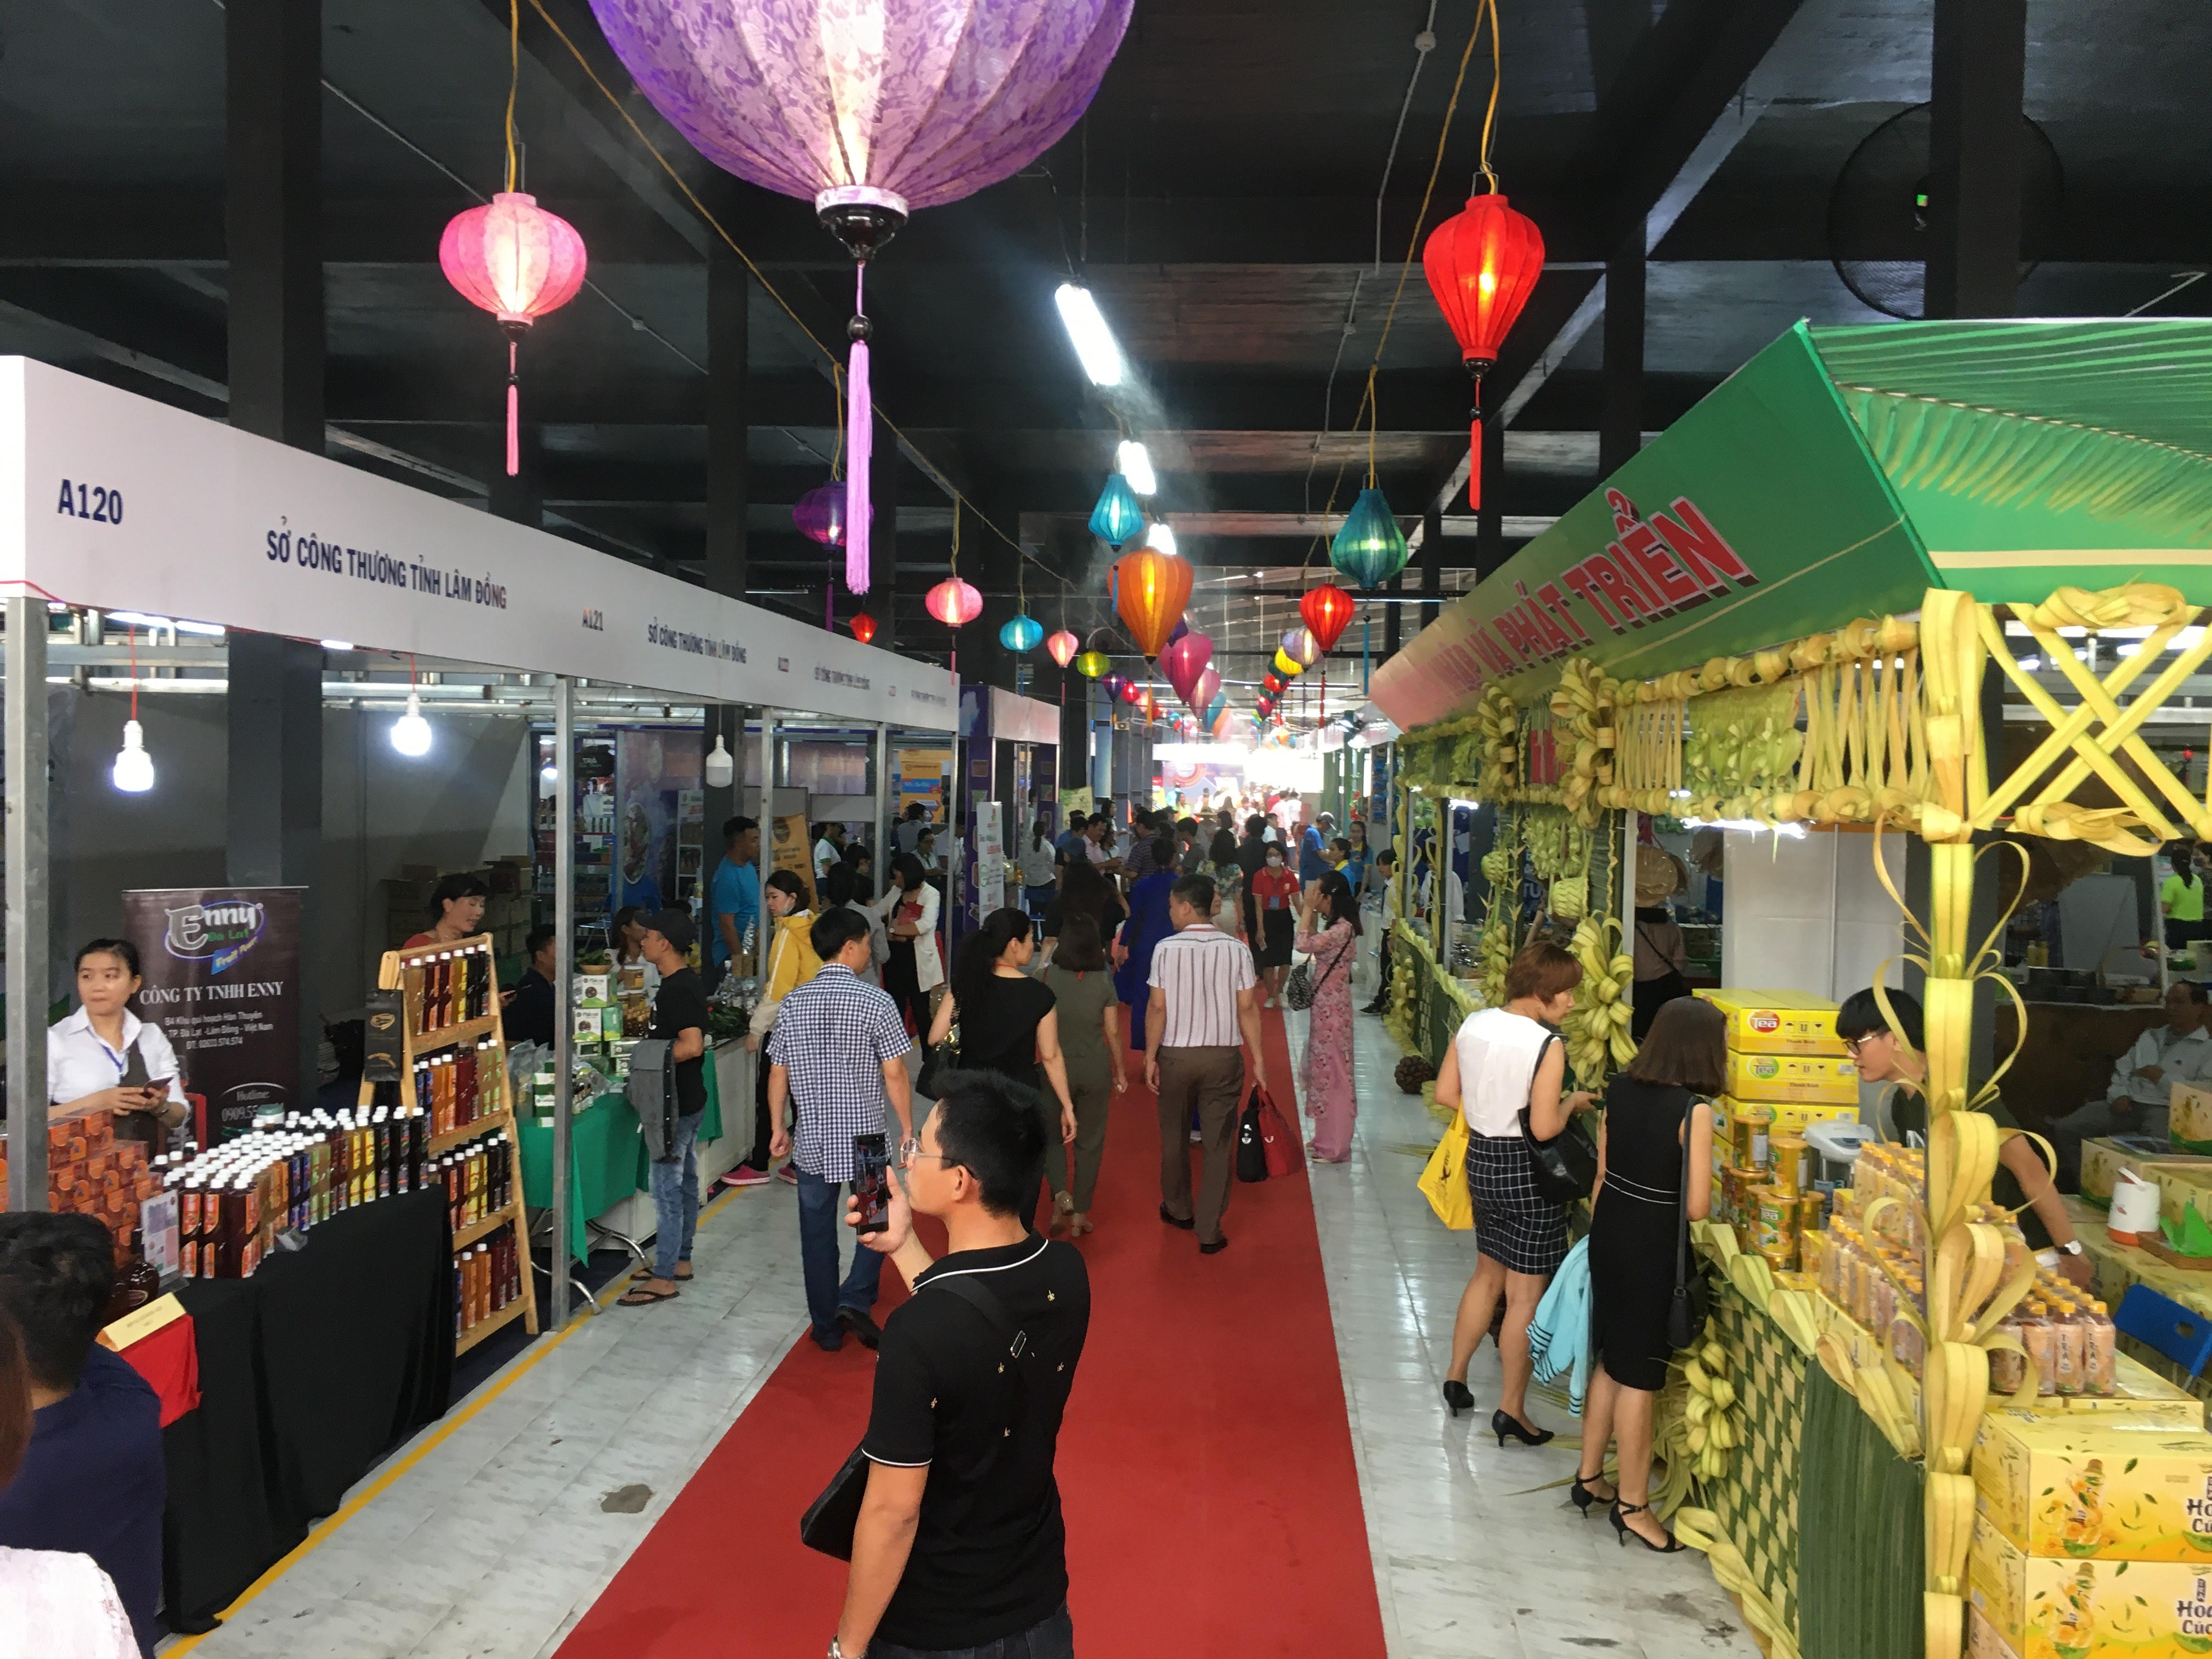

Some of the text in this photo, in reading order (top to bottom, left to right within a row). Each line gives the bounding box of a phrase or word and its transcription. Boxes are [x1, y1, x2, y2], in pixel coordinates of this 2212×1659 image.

[57, 478, 123, 526] A120
[267, 515, 507, 610] SỞ CÔNG THƯƠNG TỈNH LÂM ĐỒNG
[1559, 487, 1760, 636] TRIỂN
[582, 607, 603, 630] A121
[1492, 579, 1595, 670] PHÁT
[1463, 617, 1525, 680] VÀ
[165, 905, 256, 950] Enny
[139, 981, 284, 1005] CÔNG TY TNHH ENNY
[1750, 1017, 1778, 1030] Tea
[1753, 1064, 1778, 1075] Tea
